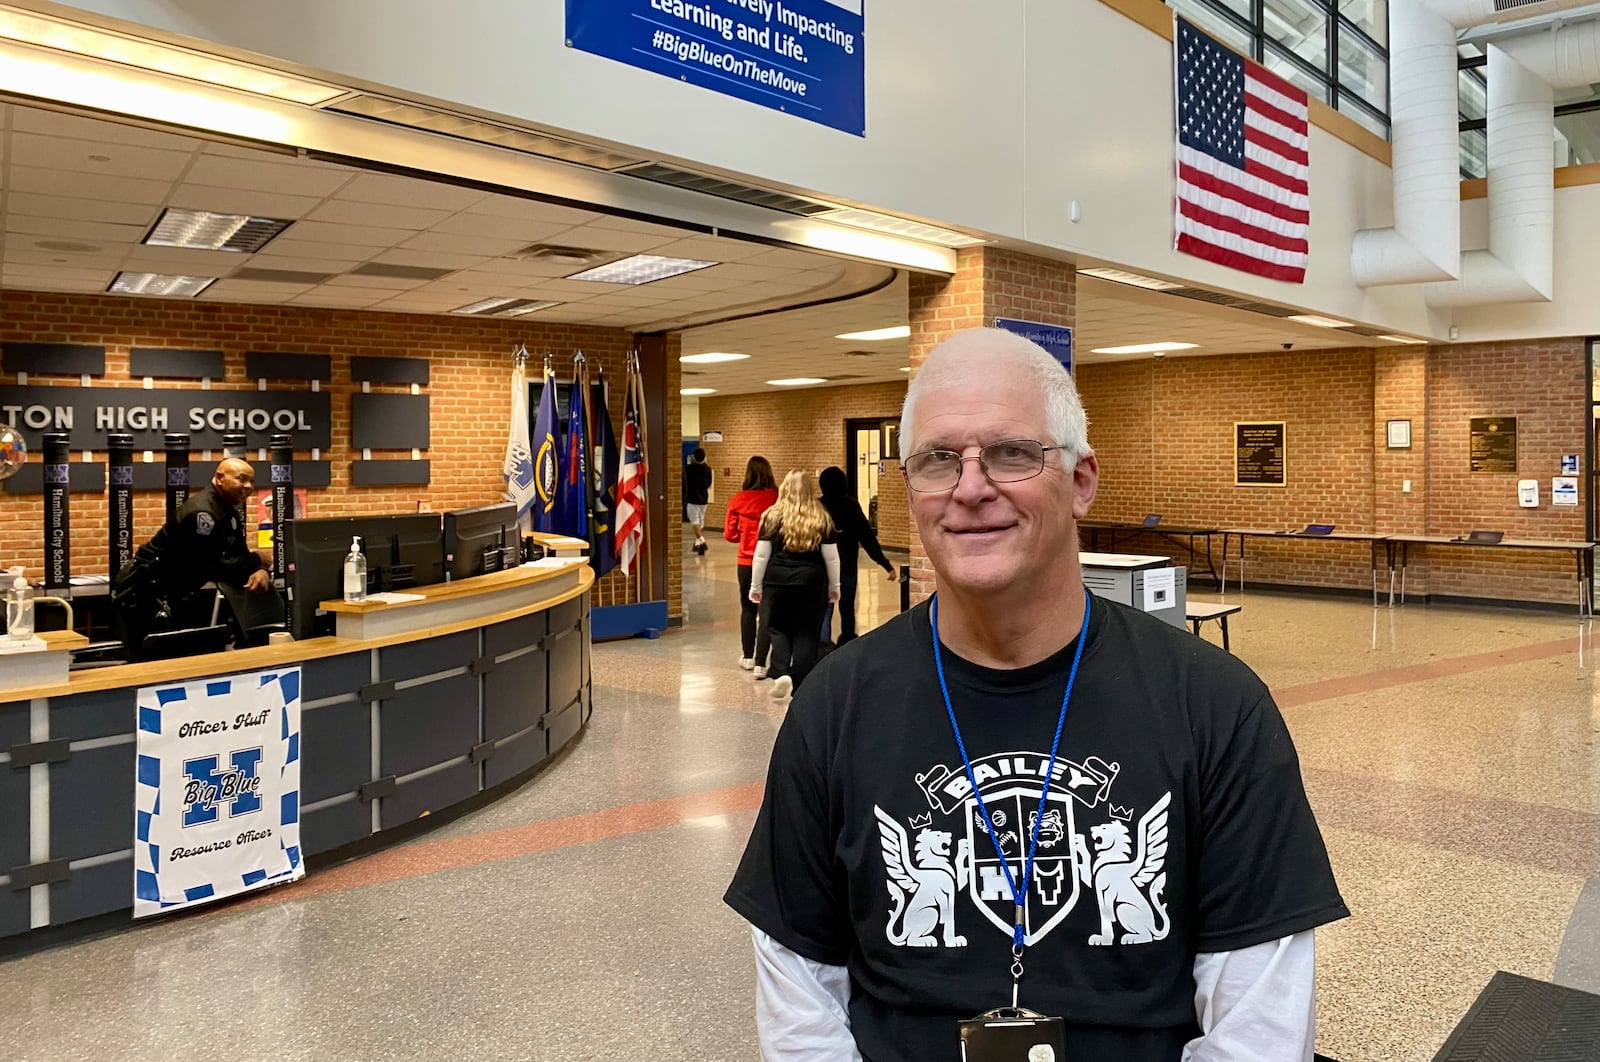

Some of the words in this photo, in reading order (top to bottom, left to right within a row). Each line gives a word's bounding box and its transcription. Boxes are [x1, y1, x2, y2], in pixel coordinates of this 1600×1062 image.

[650, 0, 734, 41] Learning
[736, 23, 770, 49] and
[774, 31, 808, 63] Life.
[777, 0, 854, 54] Impacting
[652, 30, 807, 96] #BigBlueOnTheMove
[2, 404, 74, 430] TON
[96, 405, 169, 431] HIGH
[189, 407, 312, 431] SCHOOL
[52, 488, 64, 527] Hamilton
[117, 490, 129, 528] Hamilton
[276, 486, 287, 522] Hamilton
[51, 529, 65, 548] City
[117, 530, 129, 548] City
[53, 549, 65, 584] Schools
[178, 720, 229, 738] Officer
[232, 709, 271, 730] Huff
[183, 779, 217, 810] Big
[221, 771, 261, 798] Blue
[943, 757, 1098, 799] BAILEY
[169, 839, 232, 862] Resource
[236, 828, 273, 845] Officer
